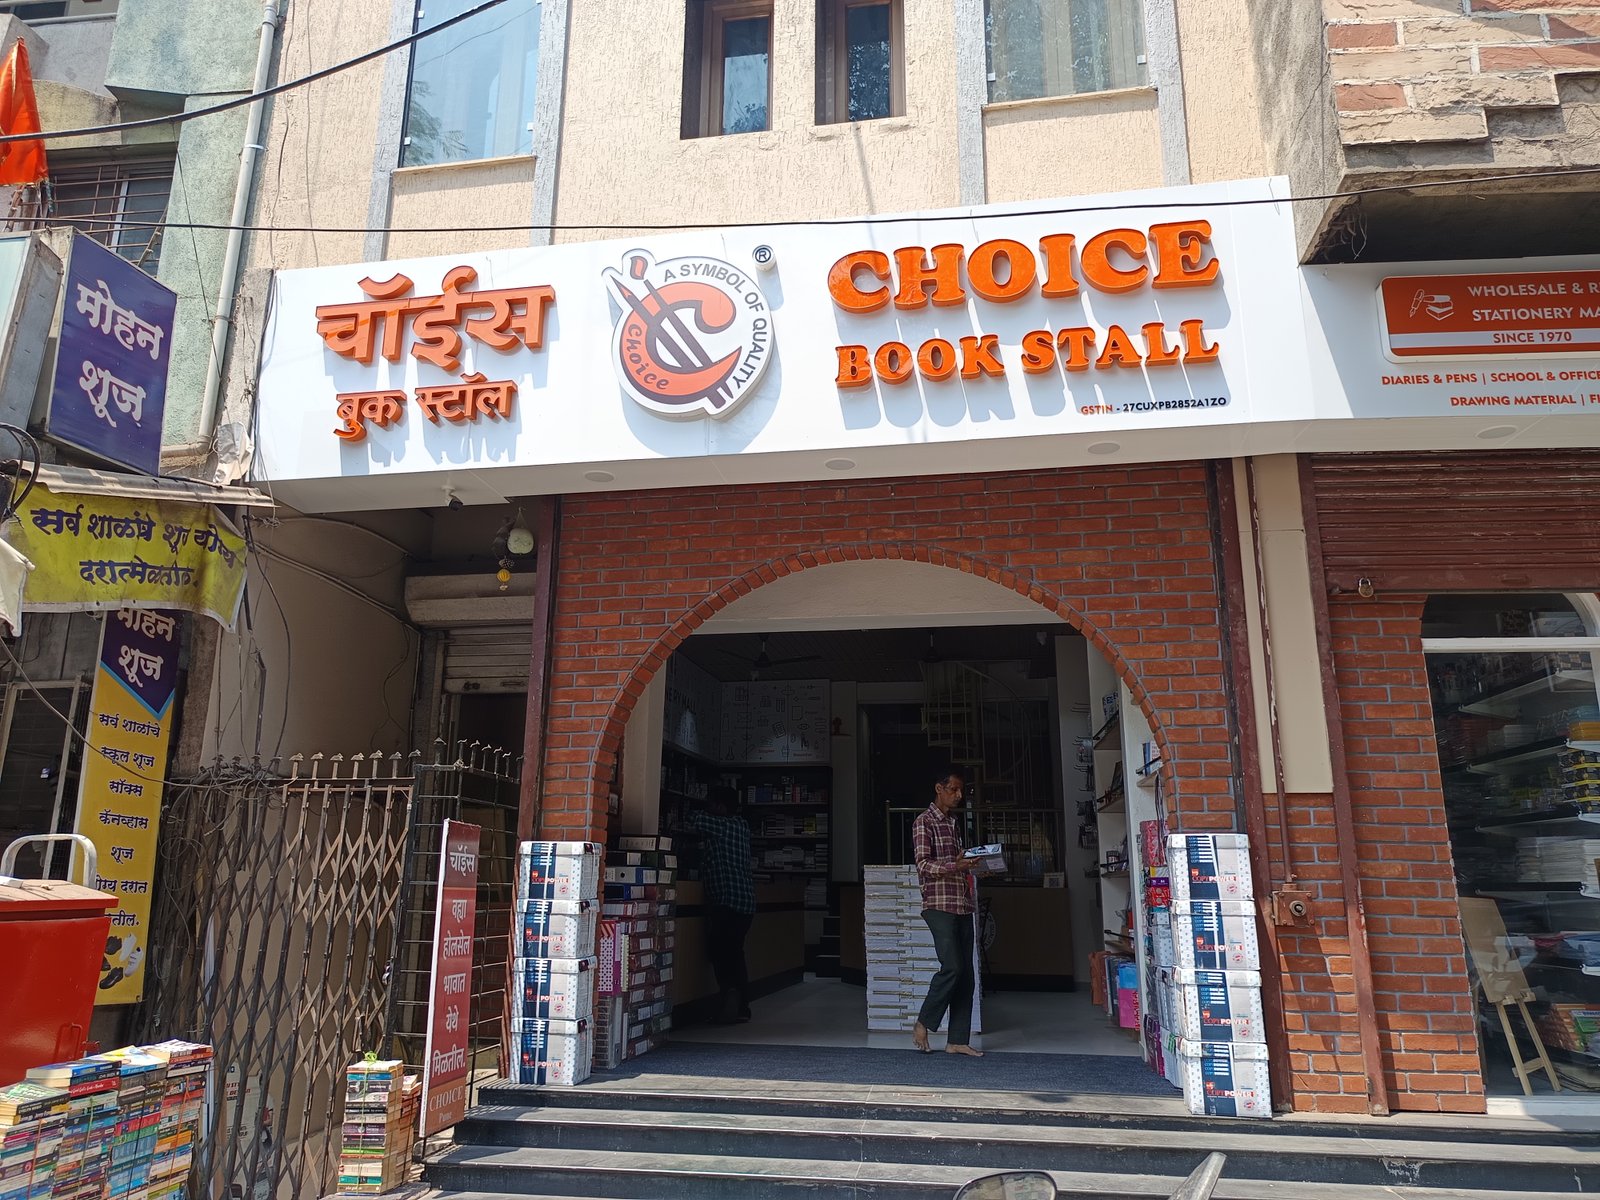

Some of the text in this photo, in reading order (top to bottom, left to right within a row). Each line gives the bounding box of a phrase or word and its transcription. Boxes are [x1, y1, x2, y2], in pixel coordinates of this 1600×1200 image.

[827, 219, 1220, 313] CHOICE
[1467, 283, 1570, 297] WHOLESALE
[1571, 282, 1584, 295] &
[77, 279, 163, 360] मोहन
[315, 265, 556, 371] चॉईस
[663, 263, 768, 389] A SYMBOL OF QUALITY
[1472, 307, 1573, 322] STATIONERY
[1493, 331, 1572, 344] SINCE 1970
[835, 318, 1220, 388] BOOK STALL
[1382, 374, 1430, 386] DIARIES
[1433, 374, 1443, 384] &
[1446, 373, 1478, 384] PENS
[1490, 371, 1543, 383] SCHOOL
[1546, 371, 1556, 381] &
[333, 371, 519, 442] बुक स्टॉल
[1080, 404, 1113, 415] GSTIN
[1450, 396, 1511, 407] DRAWING
[1513, 394, 1577, 406] MATERIAL
[30, 503, 84, 536] सर्व
[118, 645, 164, 688] शूज
[99, 713, 161, 738] सर्व शाळांचे
[101, 746, 155, 770] स्कूल शूज
[109, 778, 143, 797] सॉक्स
[111, 846, 135, 864] शूज
[450, 845, 476, 877] चॉईस
[120, 880, 148, 893] दरात
[443, 930, 471, 961] होलसेल
[443, 973, 466, 996] भावात
[445, 1004, 460, 1034] येथे
[431, 1043, 466, 1078] मिळतील.
[430, 1085, 463, 1112] CHOICE
